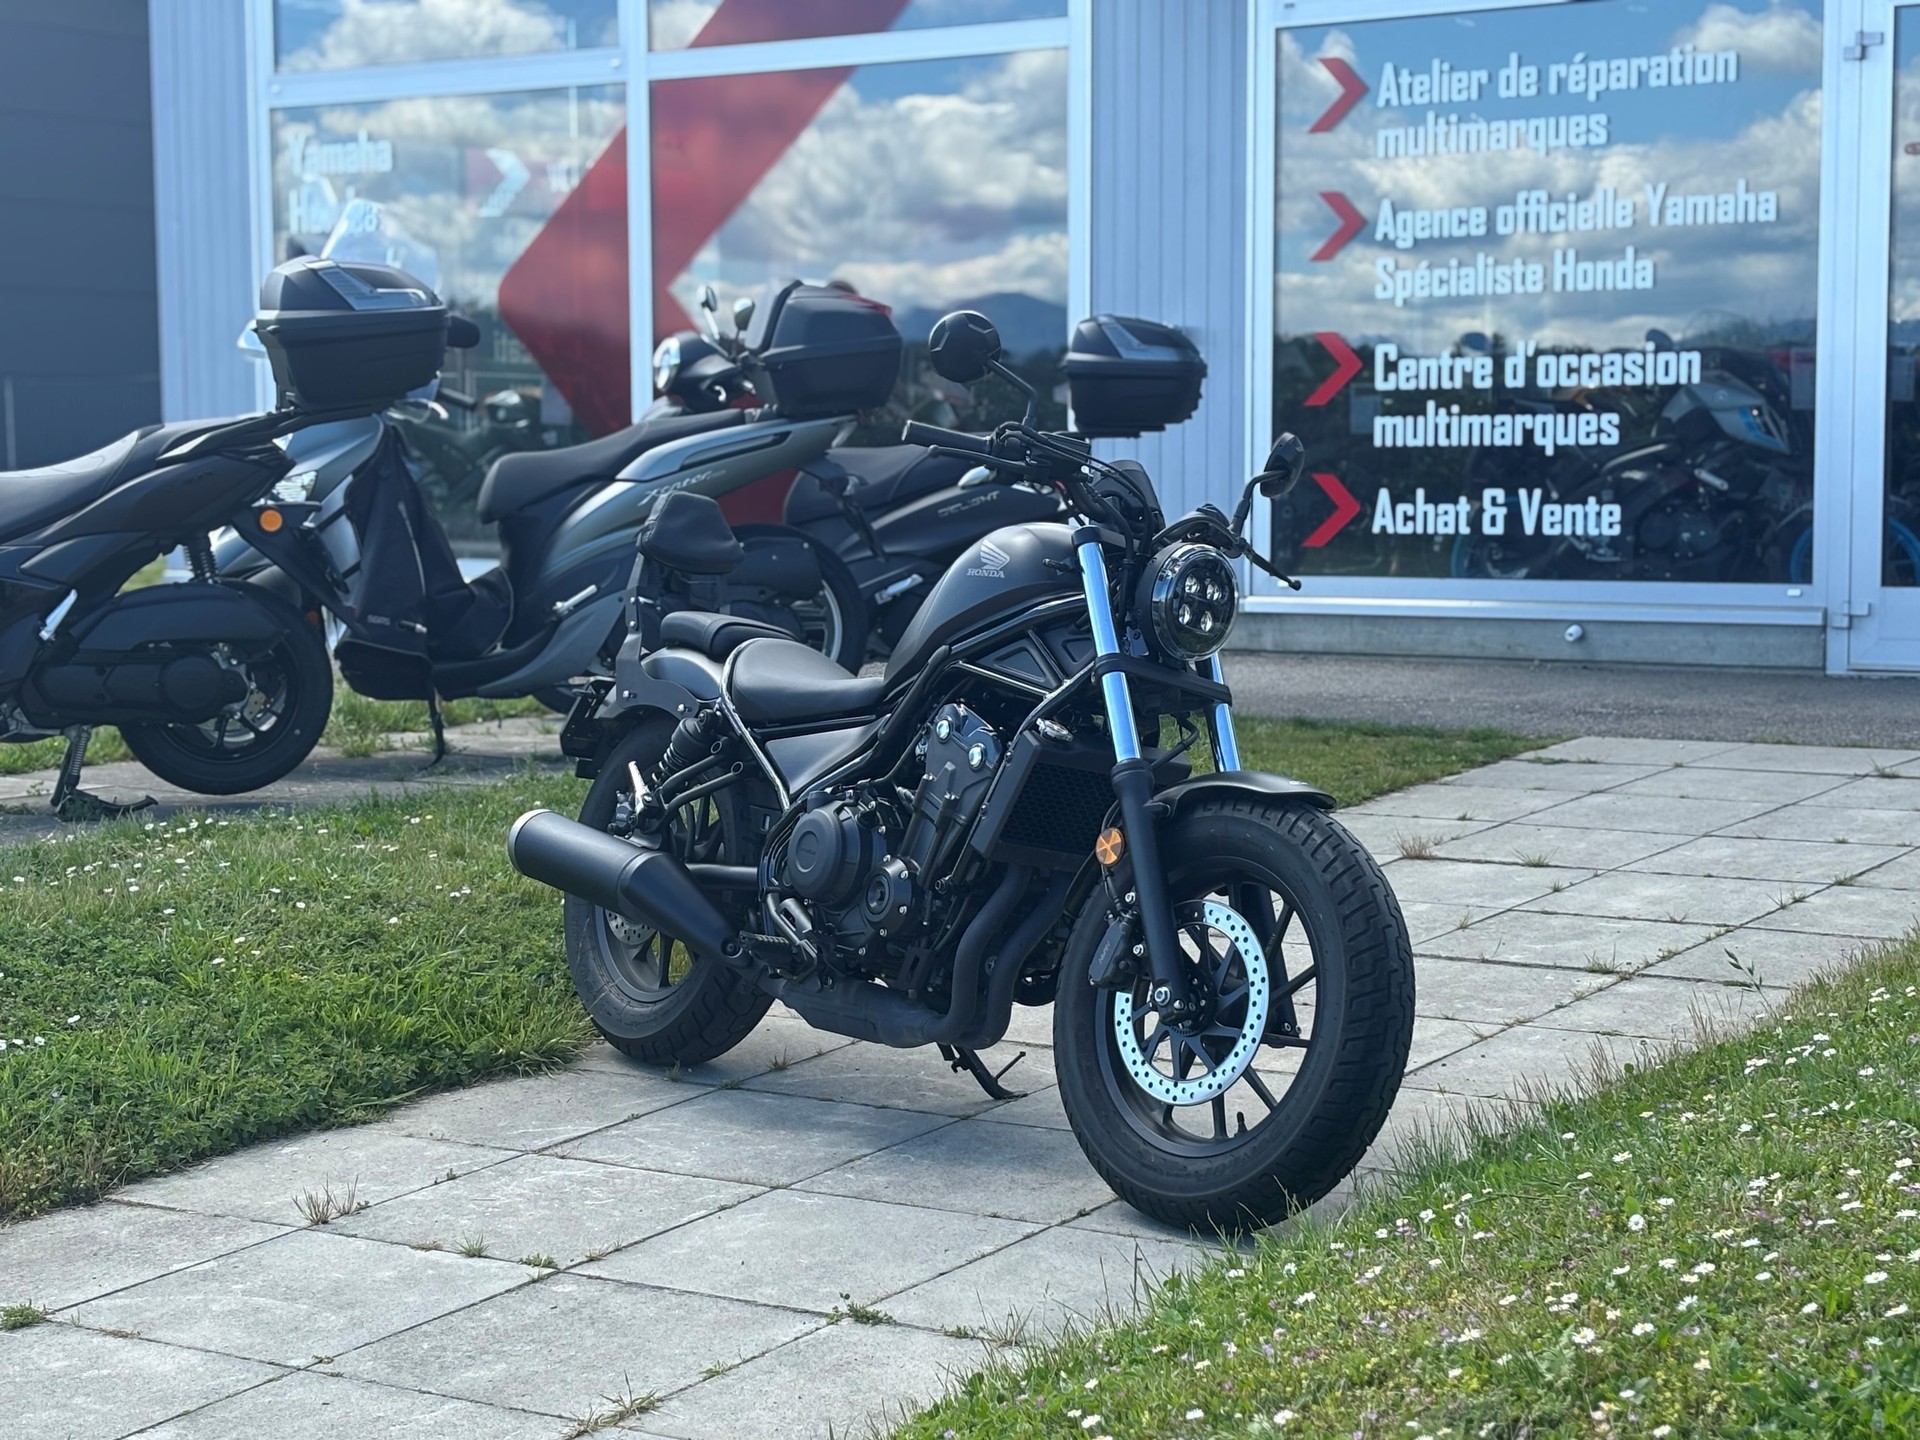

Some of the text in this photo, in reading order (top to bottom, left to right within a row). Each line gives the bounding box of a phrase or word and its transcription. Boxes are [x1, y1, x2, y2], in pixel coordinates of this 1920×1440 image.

[1376, 46, 1738, 108] Atelier de réparation
[286, 127, 393, 178] Yamaha
[1376, 110, 1609, 160] multimarques
[1374, 178, 1778, 249] Agence officielle Yamaha
[1374, 245, 1655, 307] Spécialiste Honda
[1374, 340, 1701, 391] Centre d'occasion
[1373, 400, 1620, 456] multimarques
[1372, 488, 1621, 535] Achat & Vente
[966, 568, 1006, 578] HONDA
